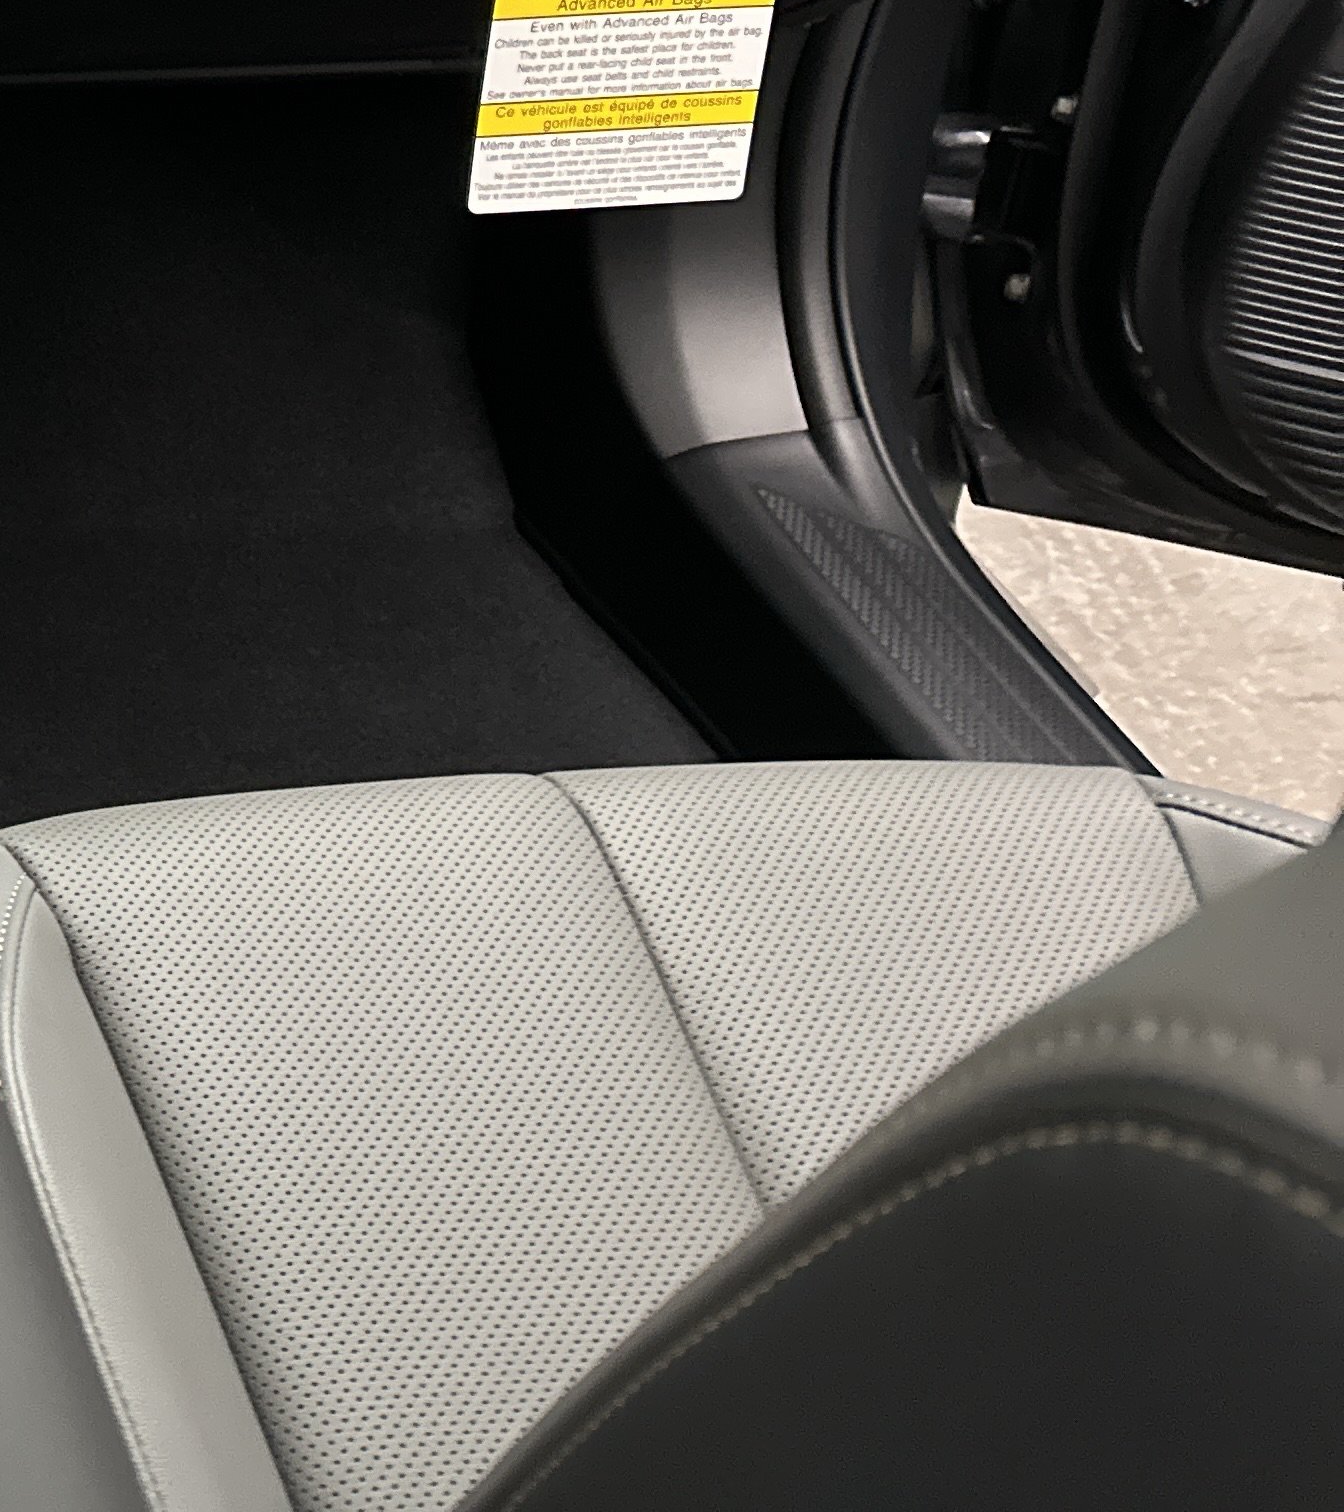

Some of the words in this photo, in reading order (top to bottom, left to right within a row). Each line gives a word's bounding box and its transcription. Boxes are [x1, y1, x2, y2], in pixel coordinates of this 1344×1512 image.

[530, 21, 564, 33] Even
[570, 18, 597, 31] with
[603, 15, 670, 29] Advanced
[675, 14, 694, 25] Air
[699, 12, 733, 26] Bags
[495, 38, 534, 49] Children
[558, 36, 570, 46] be
[601, 34, 612, 43] or
[694, 29, 706, 40] by
[710, 28, 724, 37] the
[519, 50, 537, 60] The
[591, 48, 599, 56] is
[602, 47, 616, 56] the
[681, 42, 693, 51] for
[692, 55, 706, 64] the
[495, 106, 515, 119] Ce
[521, 103, 577, 116] véhicule
[583, 101, 604, 113] est
[609, 97, 655, 113] équipé
[660, 98, 678, 109] de
[683, 94, 742, 107] coussins
[543, 115, 613, 133] gonflables
[618, 111, 692, 127] intelligents
[550, 137, 571, 147] des
